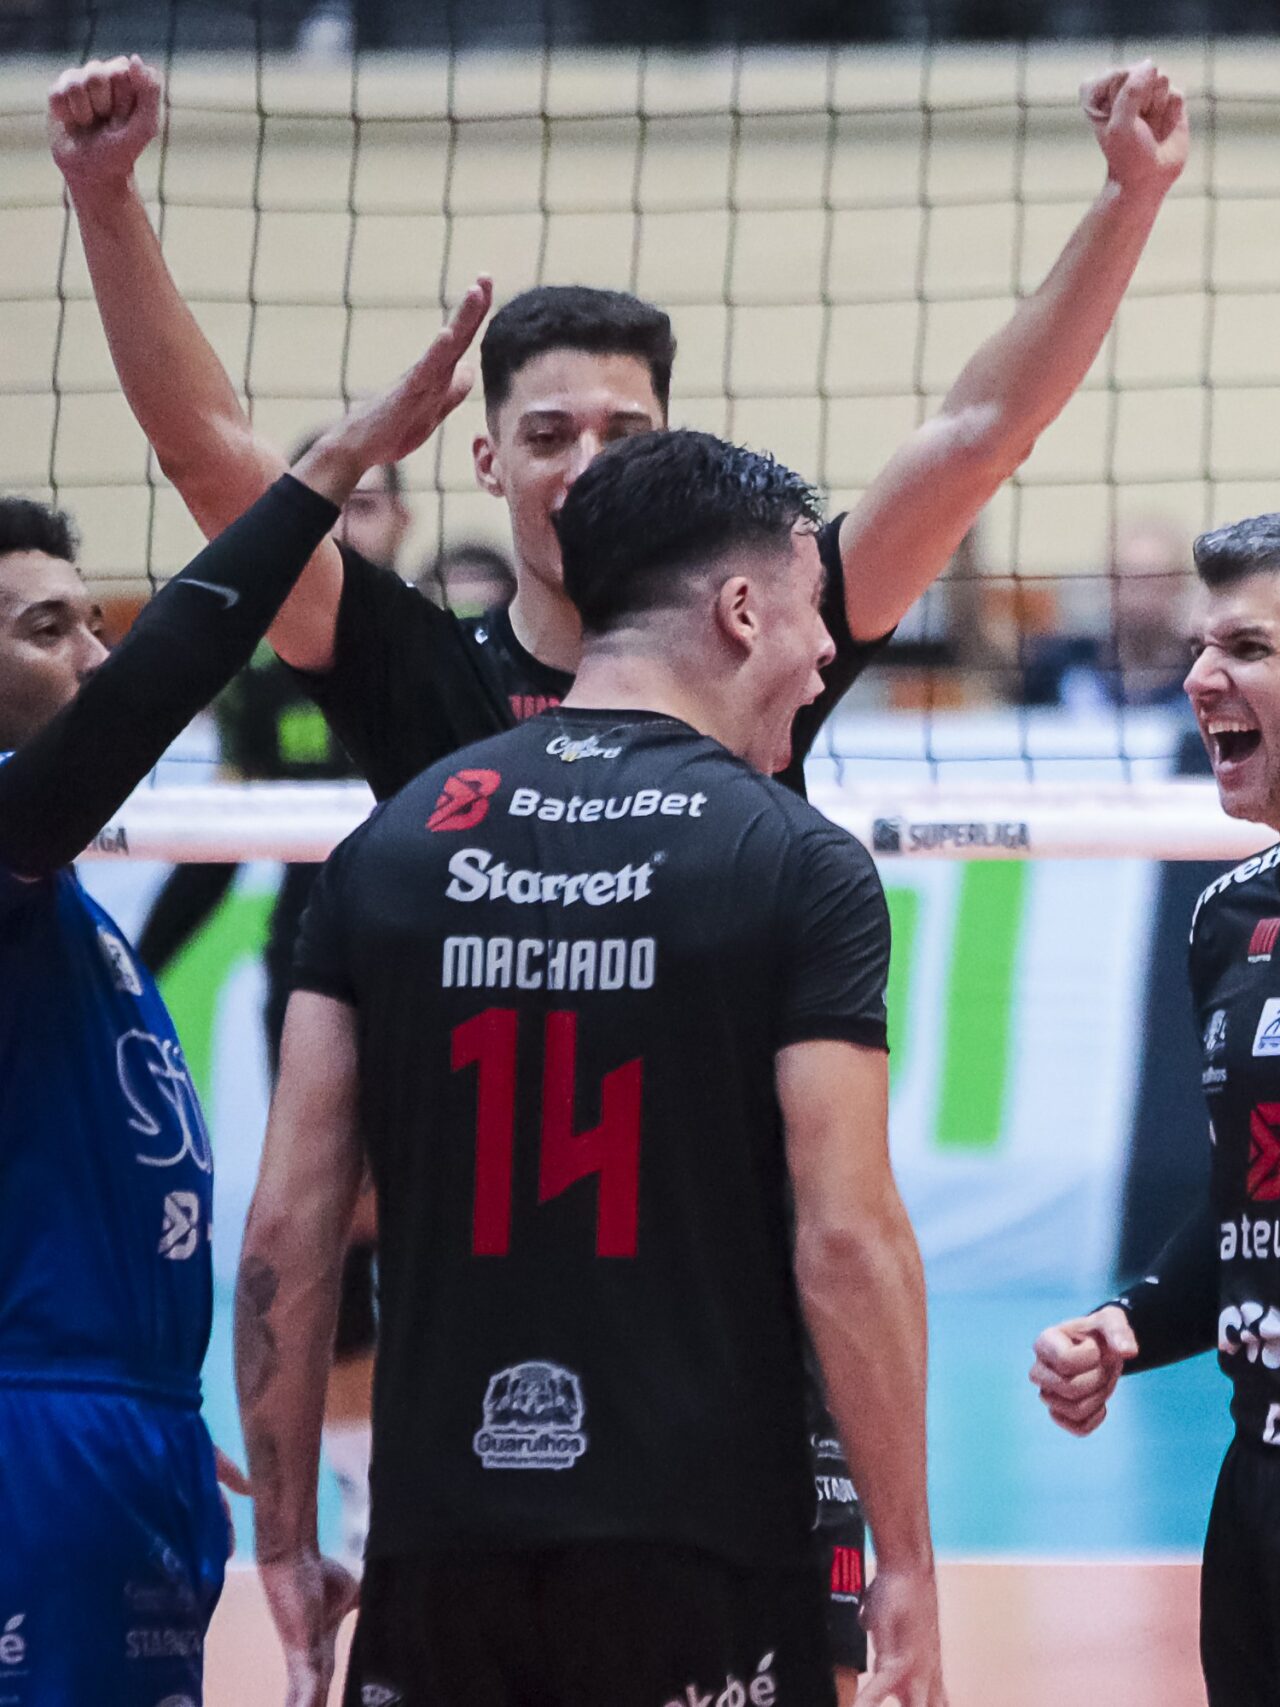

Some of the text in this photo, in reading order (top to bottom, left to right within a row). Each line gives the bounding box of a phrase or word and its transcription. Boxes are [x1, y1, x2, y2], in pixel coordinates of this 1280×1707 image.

[508, 787, 707, 823] BateuBet
[445, 848, 655, 907] Starrett
[442, 936, 657, 991] MACHADO
[451, 1007, 644, 1258] 14
[478, 1432, 581, 1453] Guarulhos
